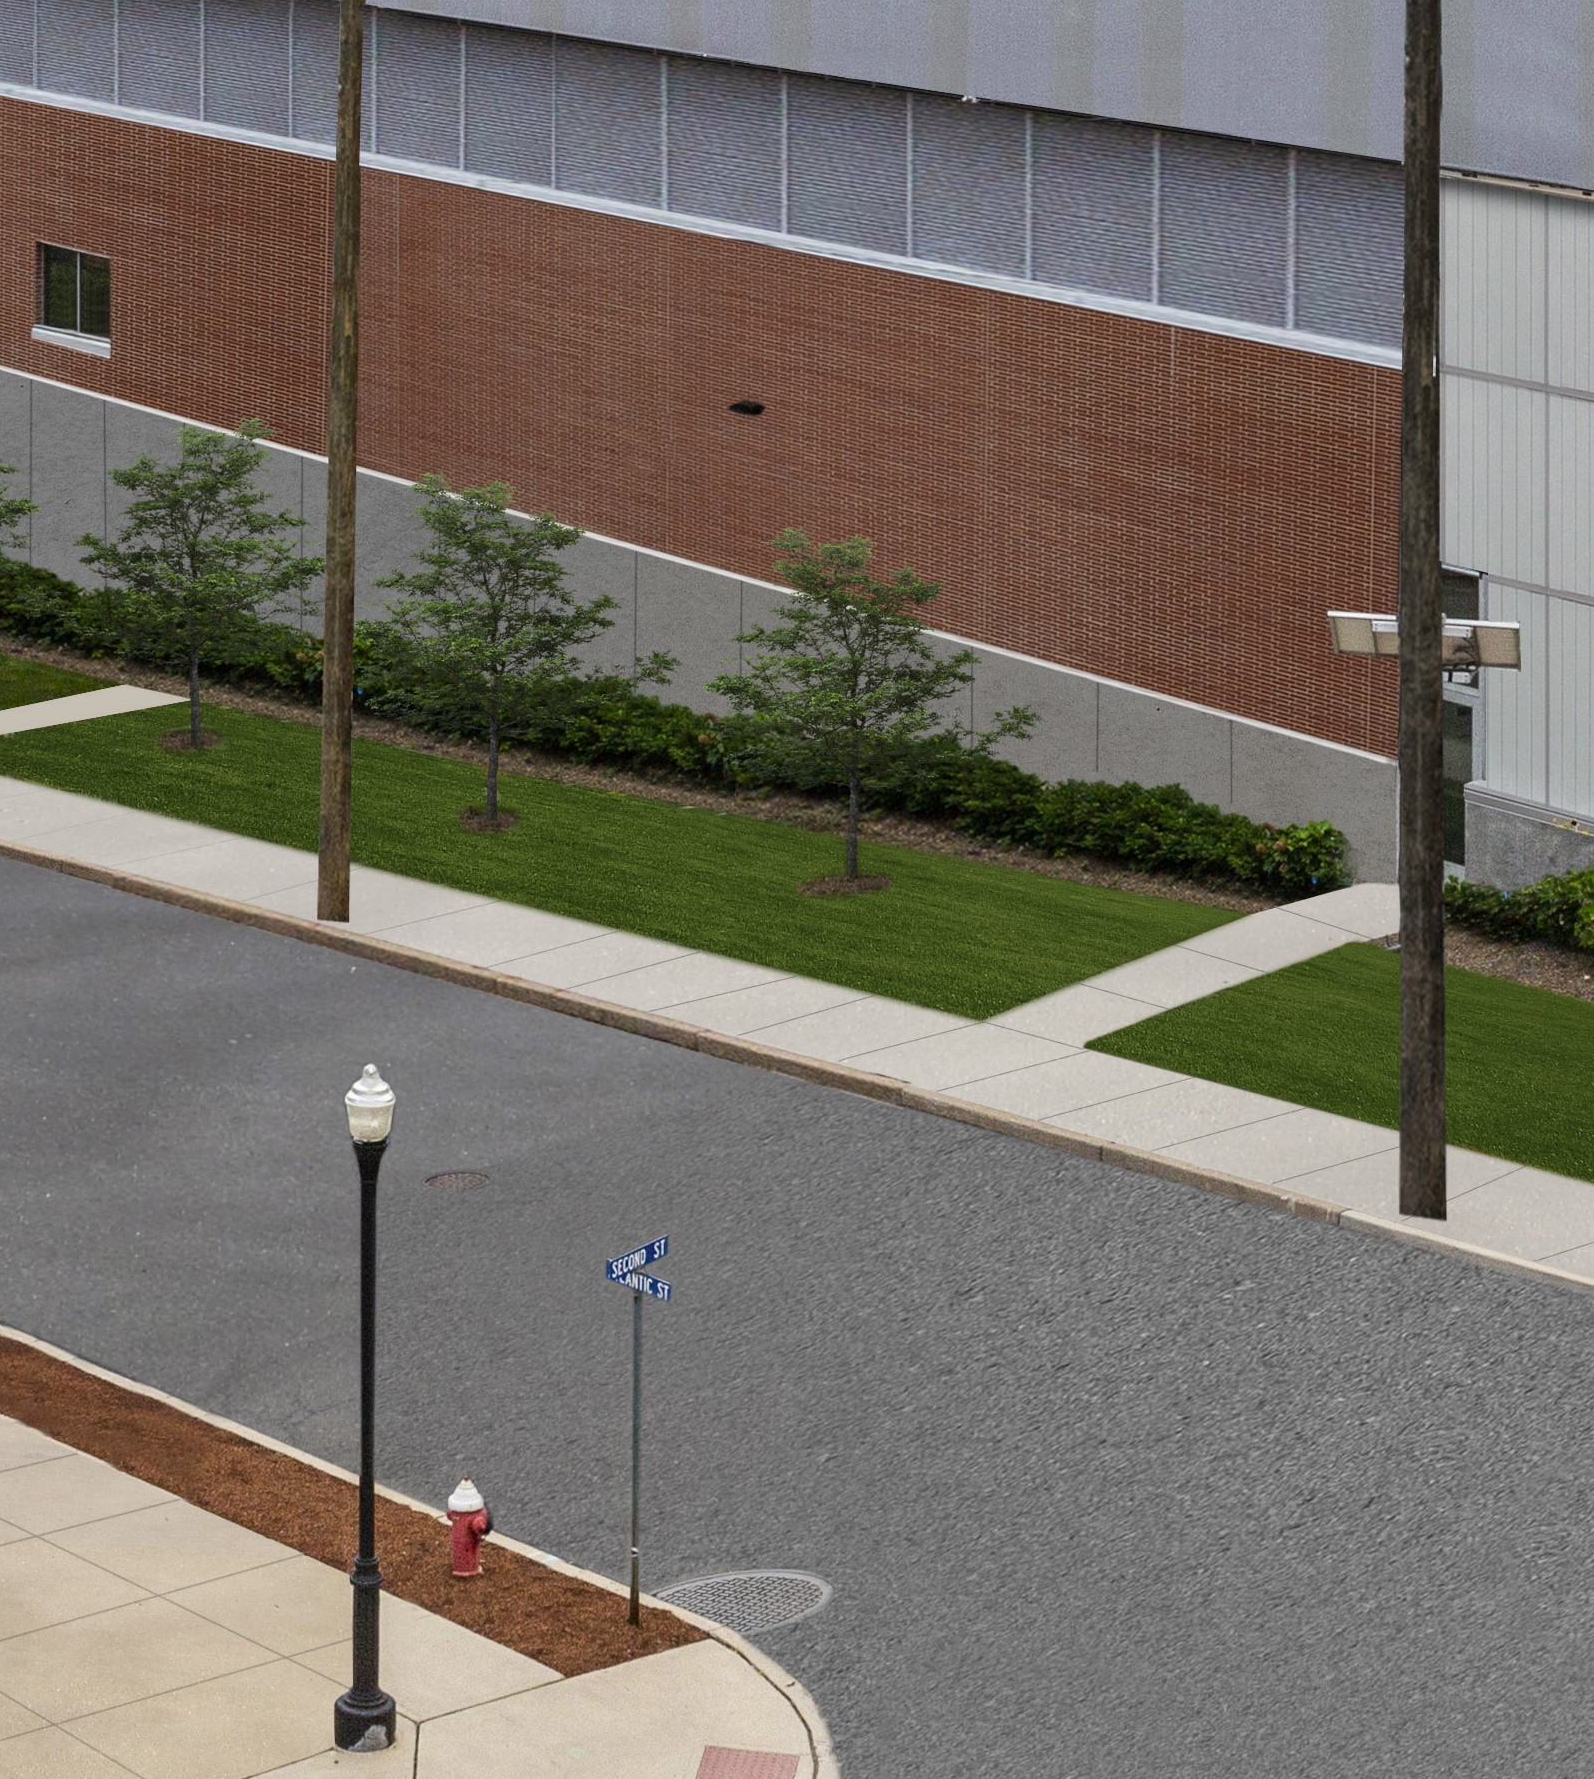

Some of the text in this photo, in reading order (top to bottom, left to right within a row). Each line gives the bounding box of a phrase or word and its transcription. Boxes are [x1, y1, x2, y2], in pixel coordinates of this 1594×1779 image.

[612, 1239, 666, 1278] SECOND ST
[615, 1273, 669, 1301] LANTIC ST
